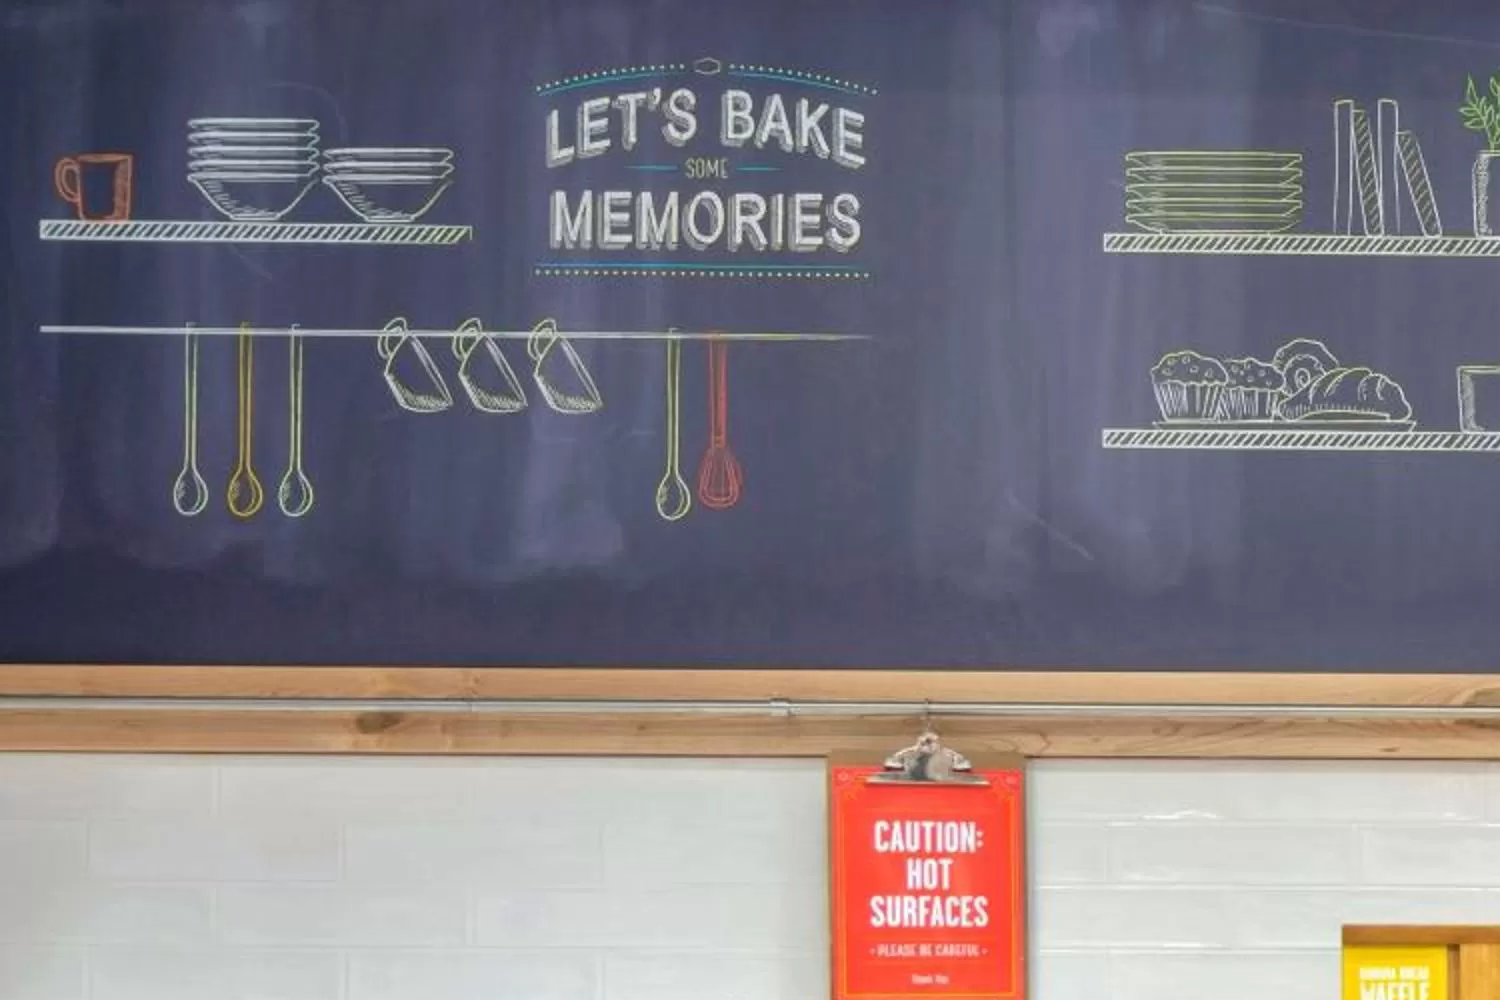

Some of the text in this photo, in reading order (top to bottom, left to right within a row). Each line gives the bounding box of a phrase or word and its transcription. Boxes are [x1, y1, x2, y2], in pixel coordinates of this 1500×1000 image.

[546, 88, 866, 168] LET'S BAKE
[685, 158, 728, 179] SOME
[550, 190, 862, 252] MEMORIES
[874, 820, 984, 854] CAUTION:
[907, 858, 953, 890] HOT
[870, 896, 989, 928] SURFACES
[877, 943, 915, 957] PLEASE
[935, 943, 980, 957] CAREFUL
